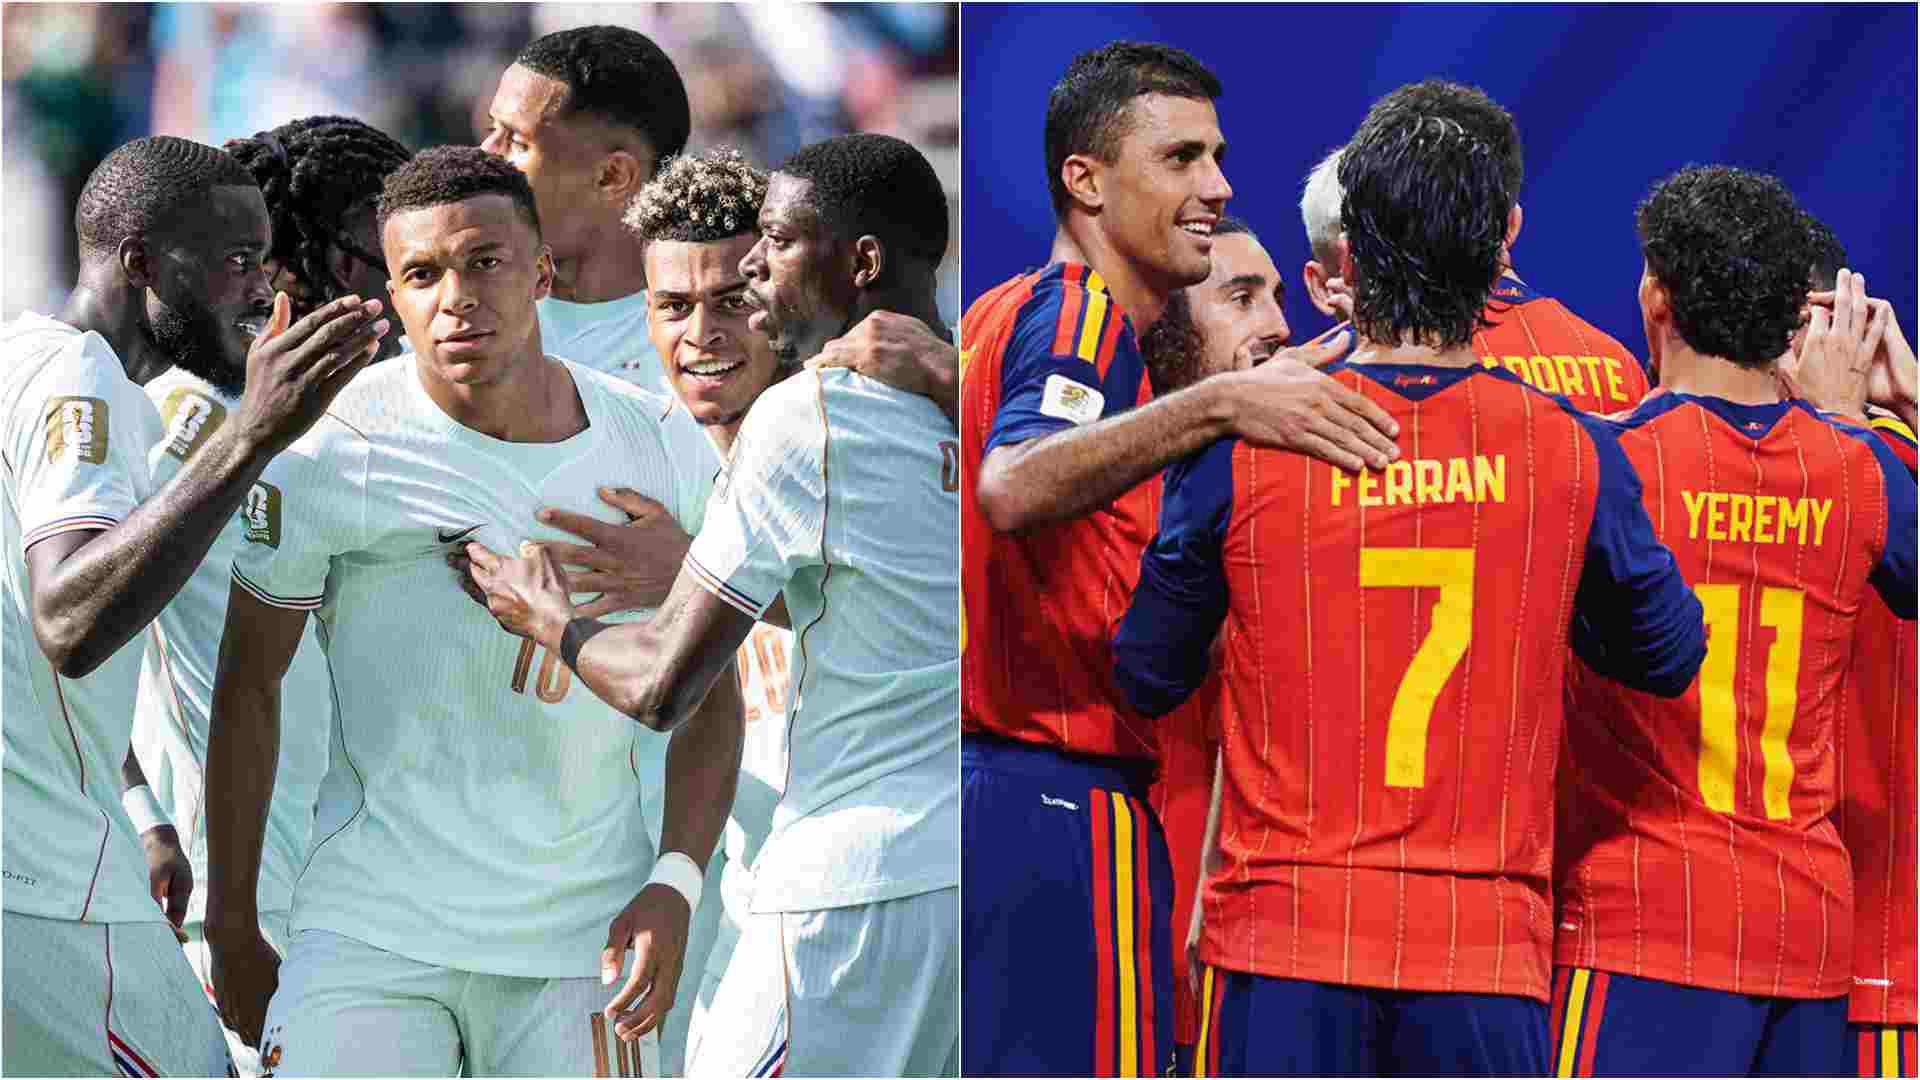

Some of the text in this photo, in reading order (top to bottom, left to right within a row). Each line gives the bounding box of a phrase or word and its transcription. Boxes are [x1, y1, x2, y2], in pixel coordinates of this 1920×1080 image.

[1481, 354, 1630, 402] PORTE
[1331, 454, 1505, 507] FERRAN
[1680, 490, 1833, 546] YEREMY
[1360, 547, 1475, 788] 7
[1694, 584, 1806, 820] 11
